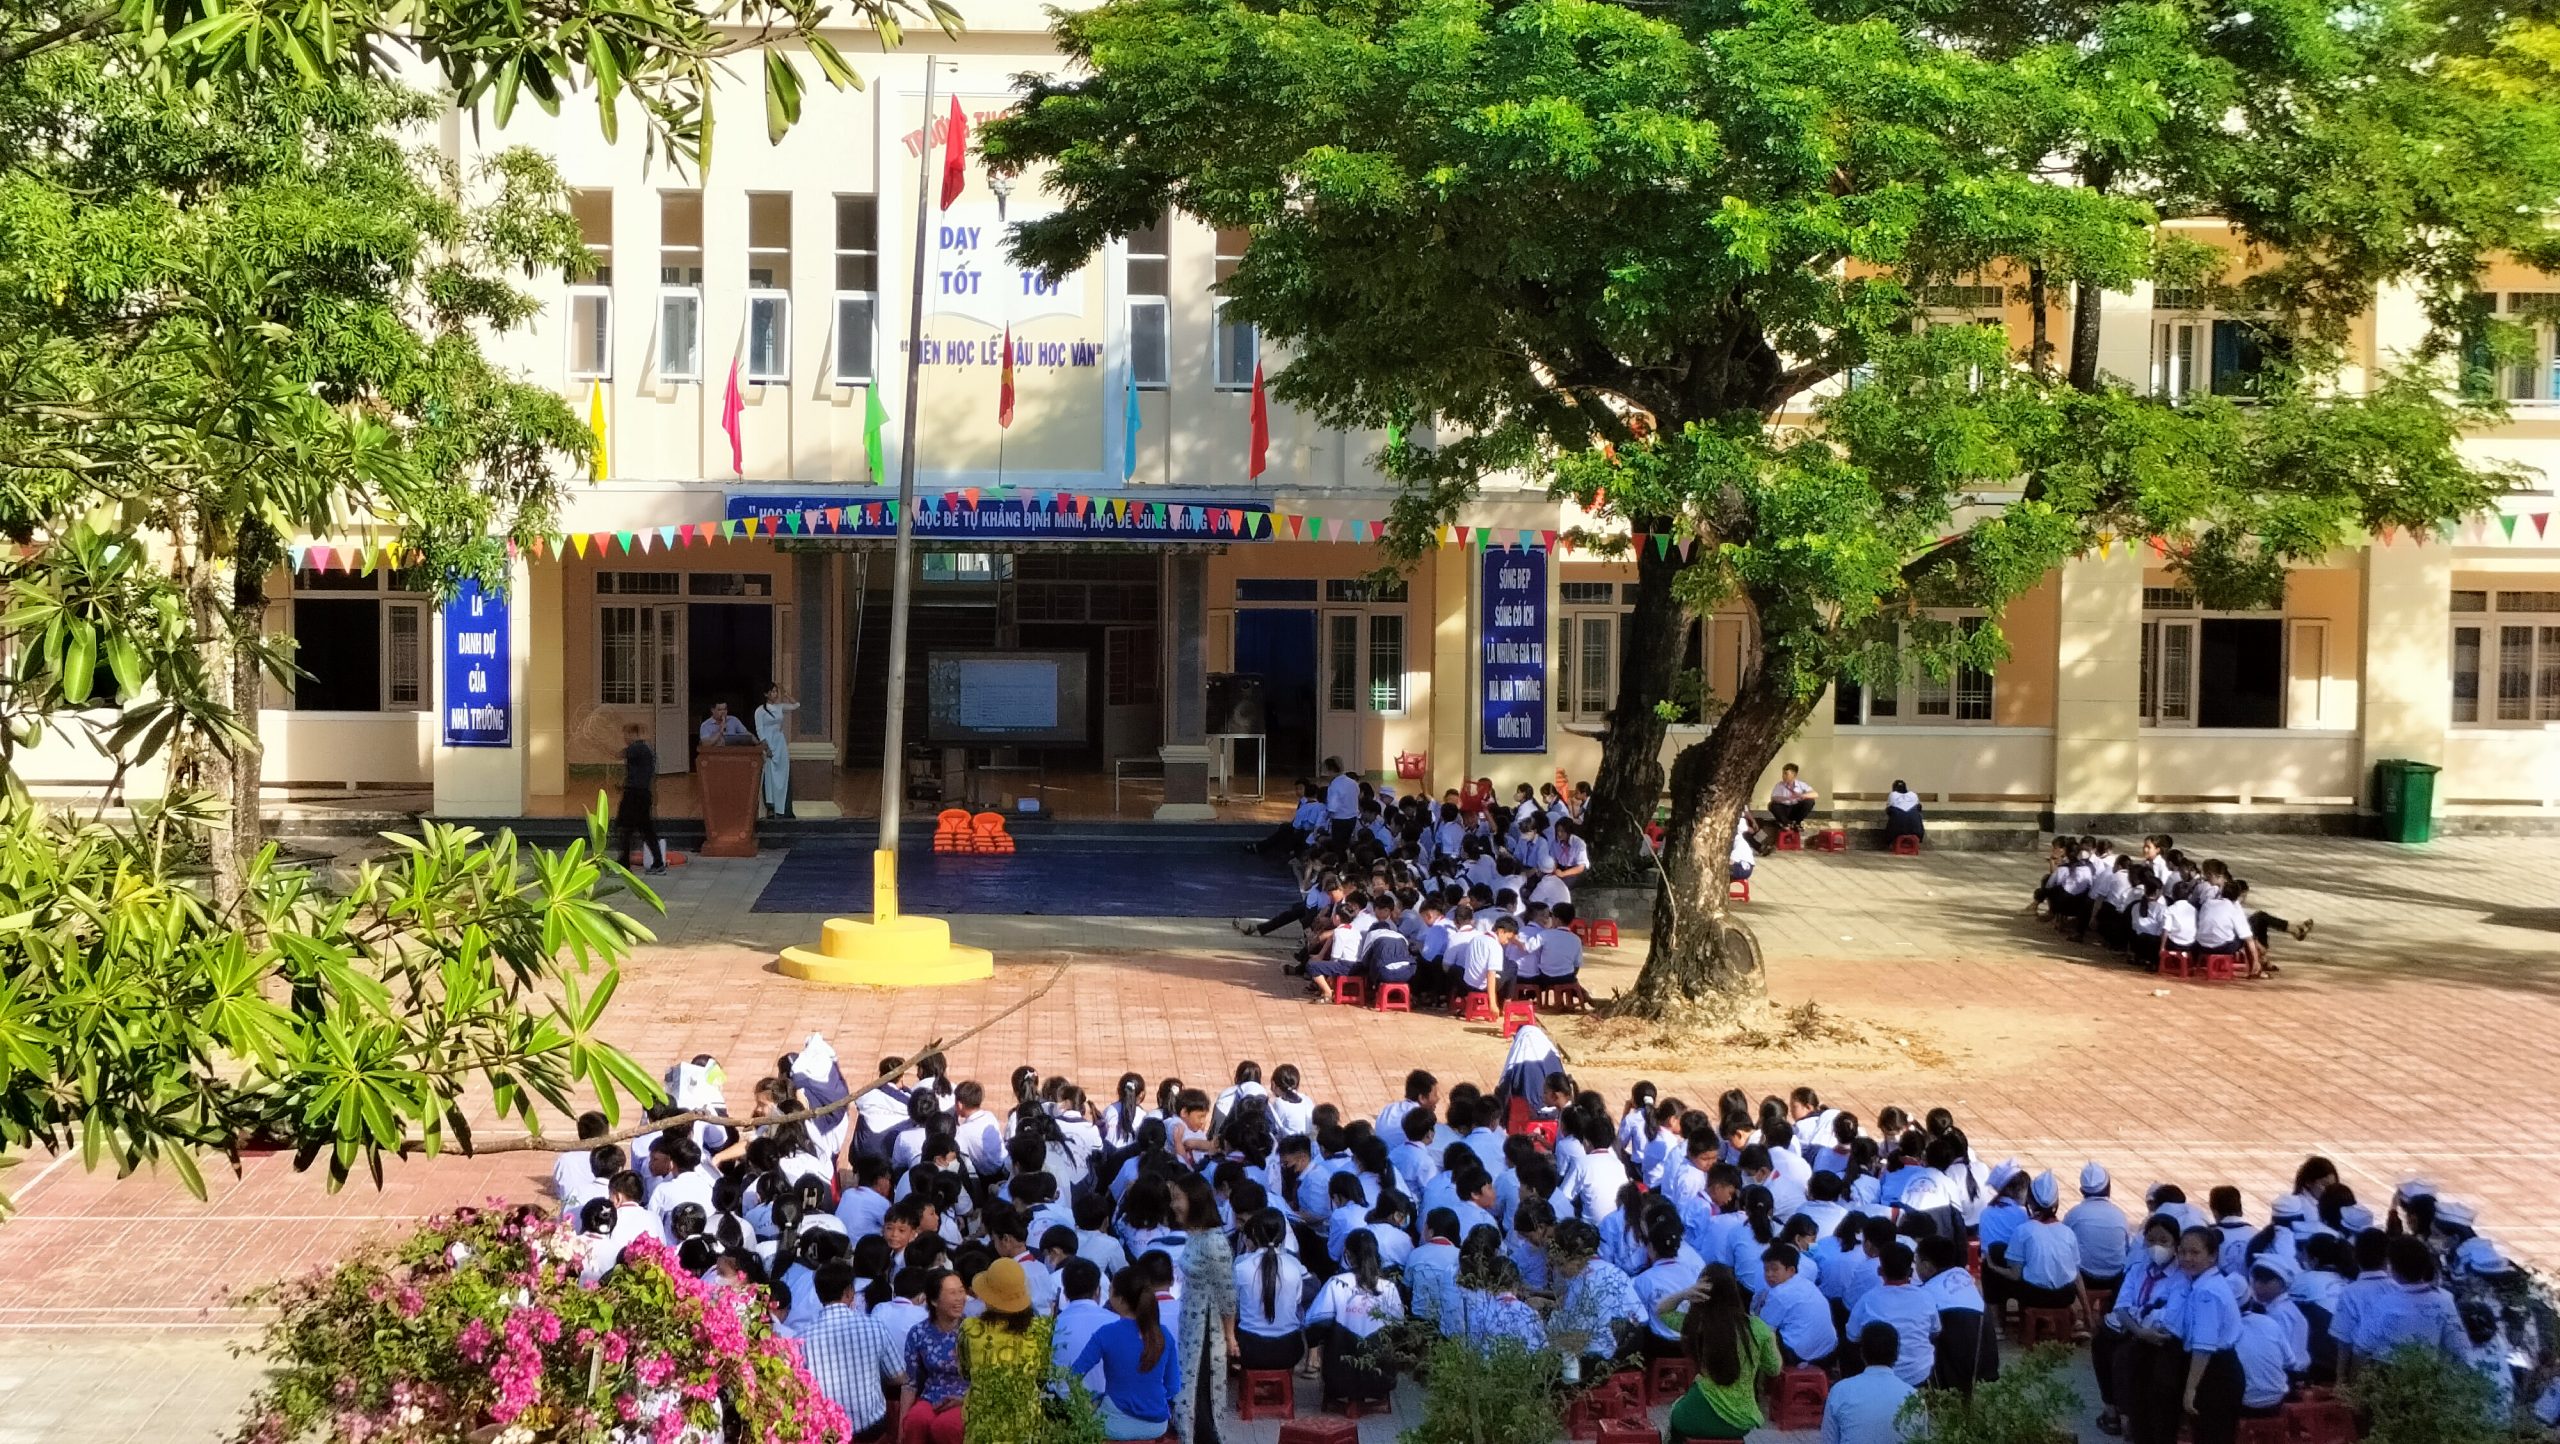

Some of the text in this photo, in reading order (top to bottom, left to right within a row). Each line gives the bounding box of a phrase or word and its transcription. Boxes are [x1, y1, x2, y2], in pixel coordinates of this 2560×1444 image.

[939, 226, 982, 256] DẠY
[939, 260, 982, 295] TỐT
[946, 341, 975, 373] HỌC
[1038, 342, 1067, 374] HỌC
[963, 509, 980, 531] TỰ
[1023, 511, 1051, 532] ĐỊNH
[1499, 560, 1531, 594] SỐNG ĐẸP
[1494, 597, 1534, 627] SỐNG CÓ ÍCH
[458, 628, 497, 660] DANH DỰ
[1487, 637, 1496, 664] LÀ
[1519, 637, 1530, 664] GIÁ
[1531, 643, 1543, 669] TRỊ
[468, 662, 487, 693] CỦA
[451, 702, 504, 731] NHÀ TRƯỜNG
